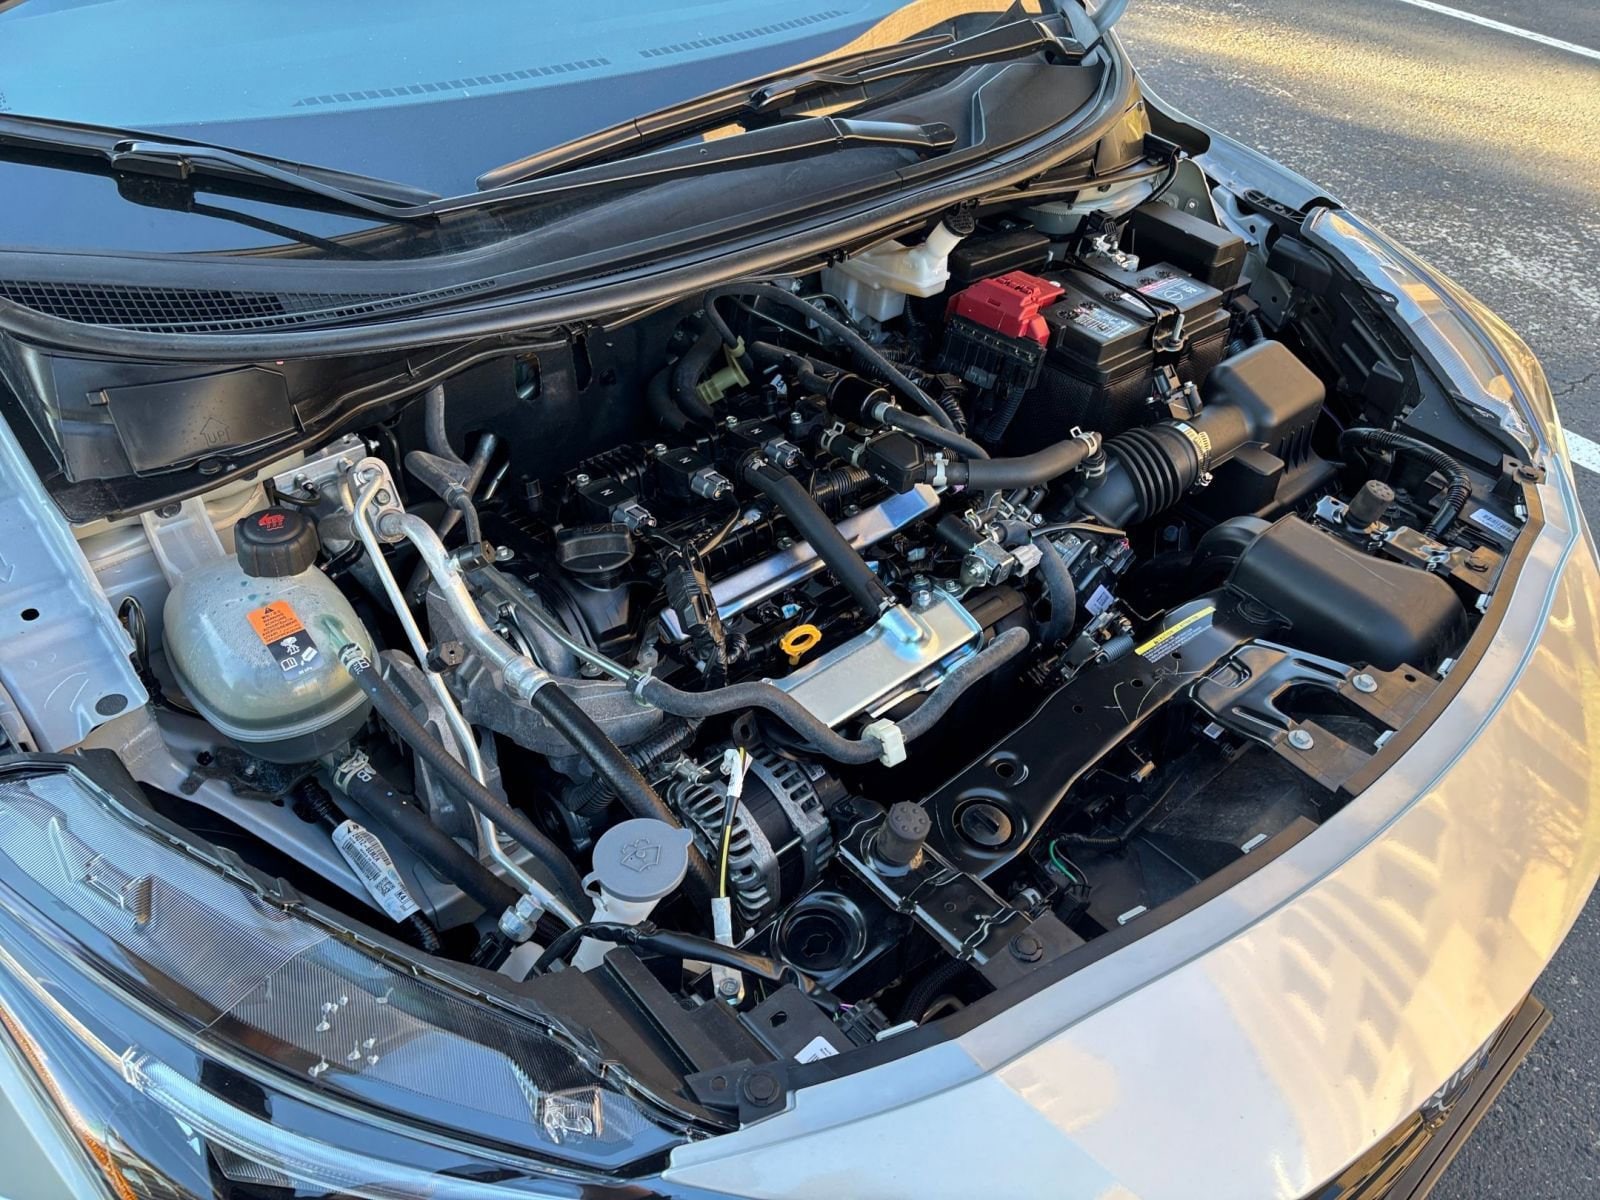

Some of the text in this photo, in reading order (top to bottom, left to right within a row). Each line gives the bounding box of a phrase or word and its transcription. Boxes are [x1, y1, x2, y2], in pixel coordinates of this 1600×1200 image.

[208, 431, 225, 443] UP
[357, 769, 372, 782] B
[396, 889, 407, 901] K4
